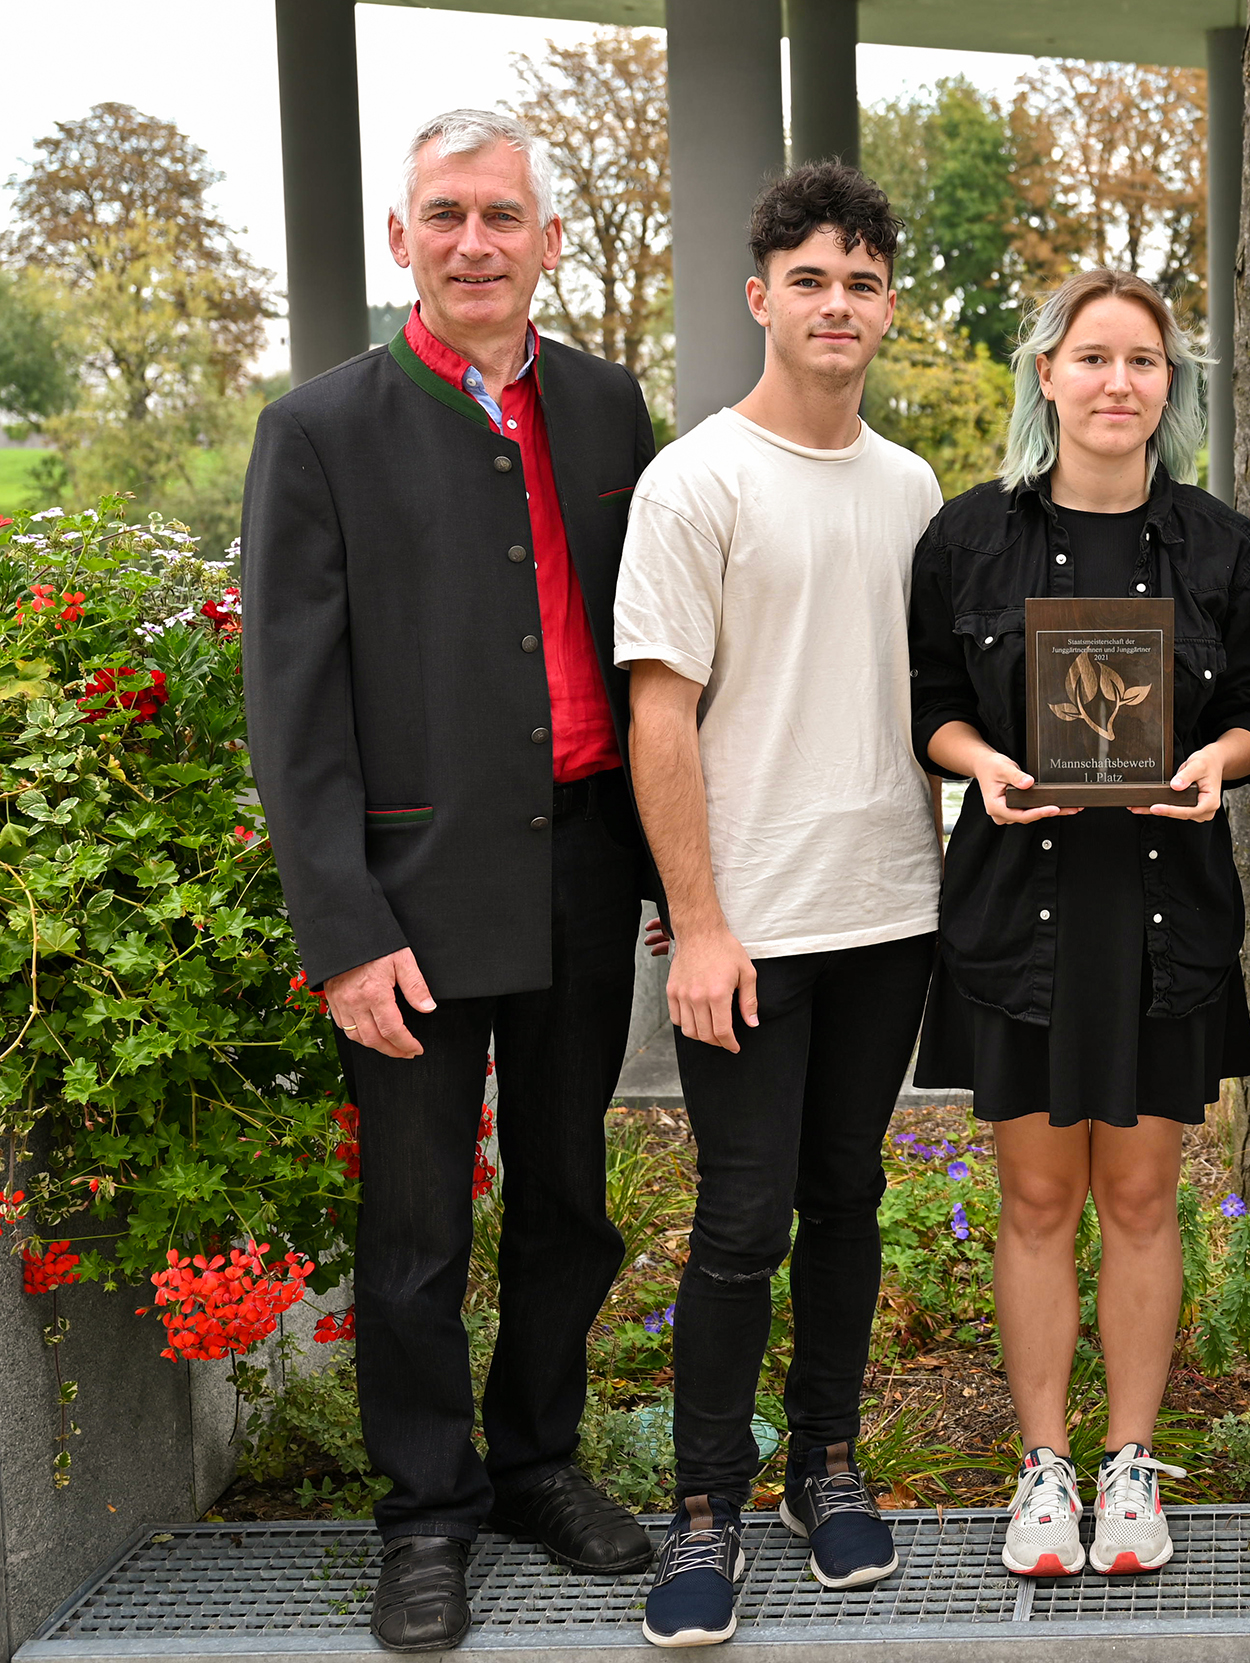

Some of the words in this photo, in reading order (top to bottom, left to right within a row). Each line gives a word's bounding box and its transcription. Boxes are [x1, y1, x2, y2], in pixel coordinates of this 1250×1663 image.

[1067, 638, 1124, 646] Staatsmeisterschaft
[1124, 638, 1136, 646] der
[1116, 645, 1152, 655] Junggärtner
[1049, 757, 1157, 769] Mannschaftsbewerb
[1083, 772, 1093, 783] 1.
[1096, 771, 1124, 783] Platz
